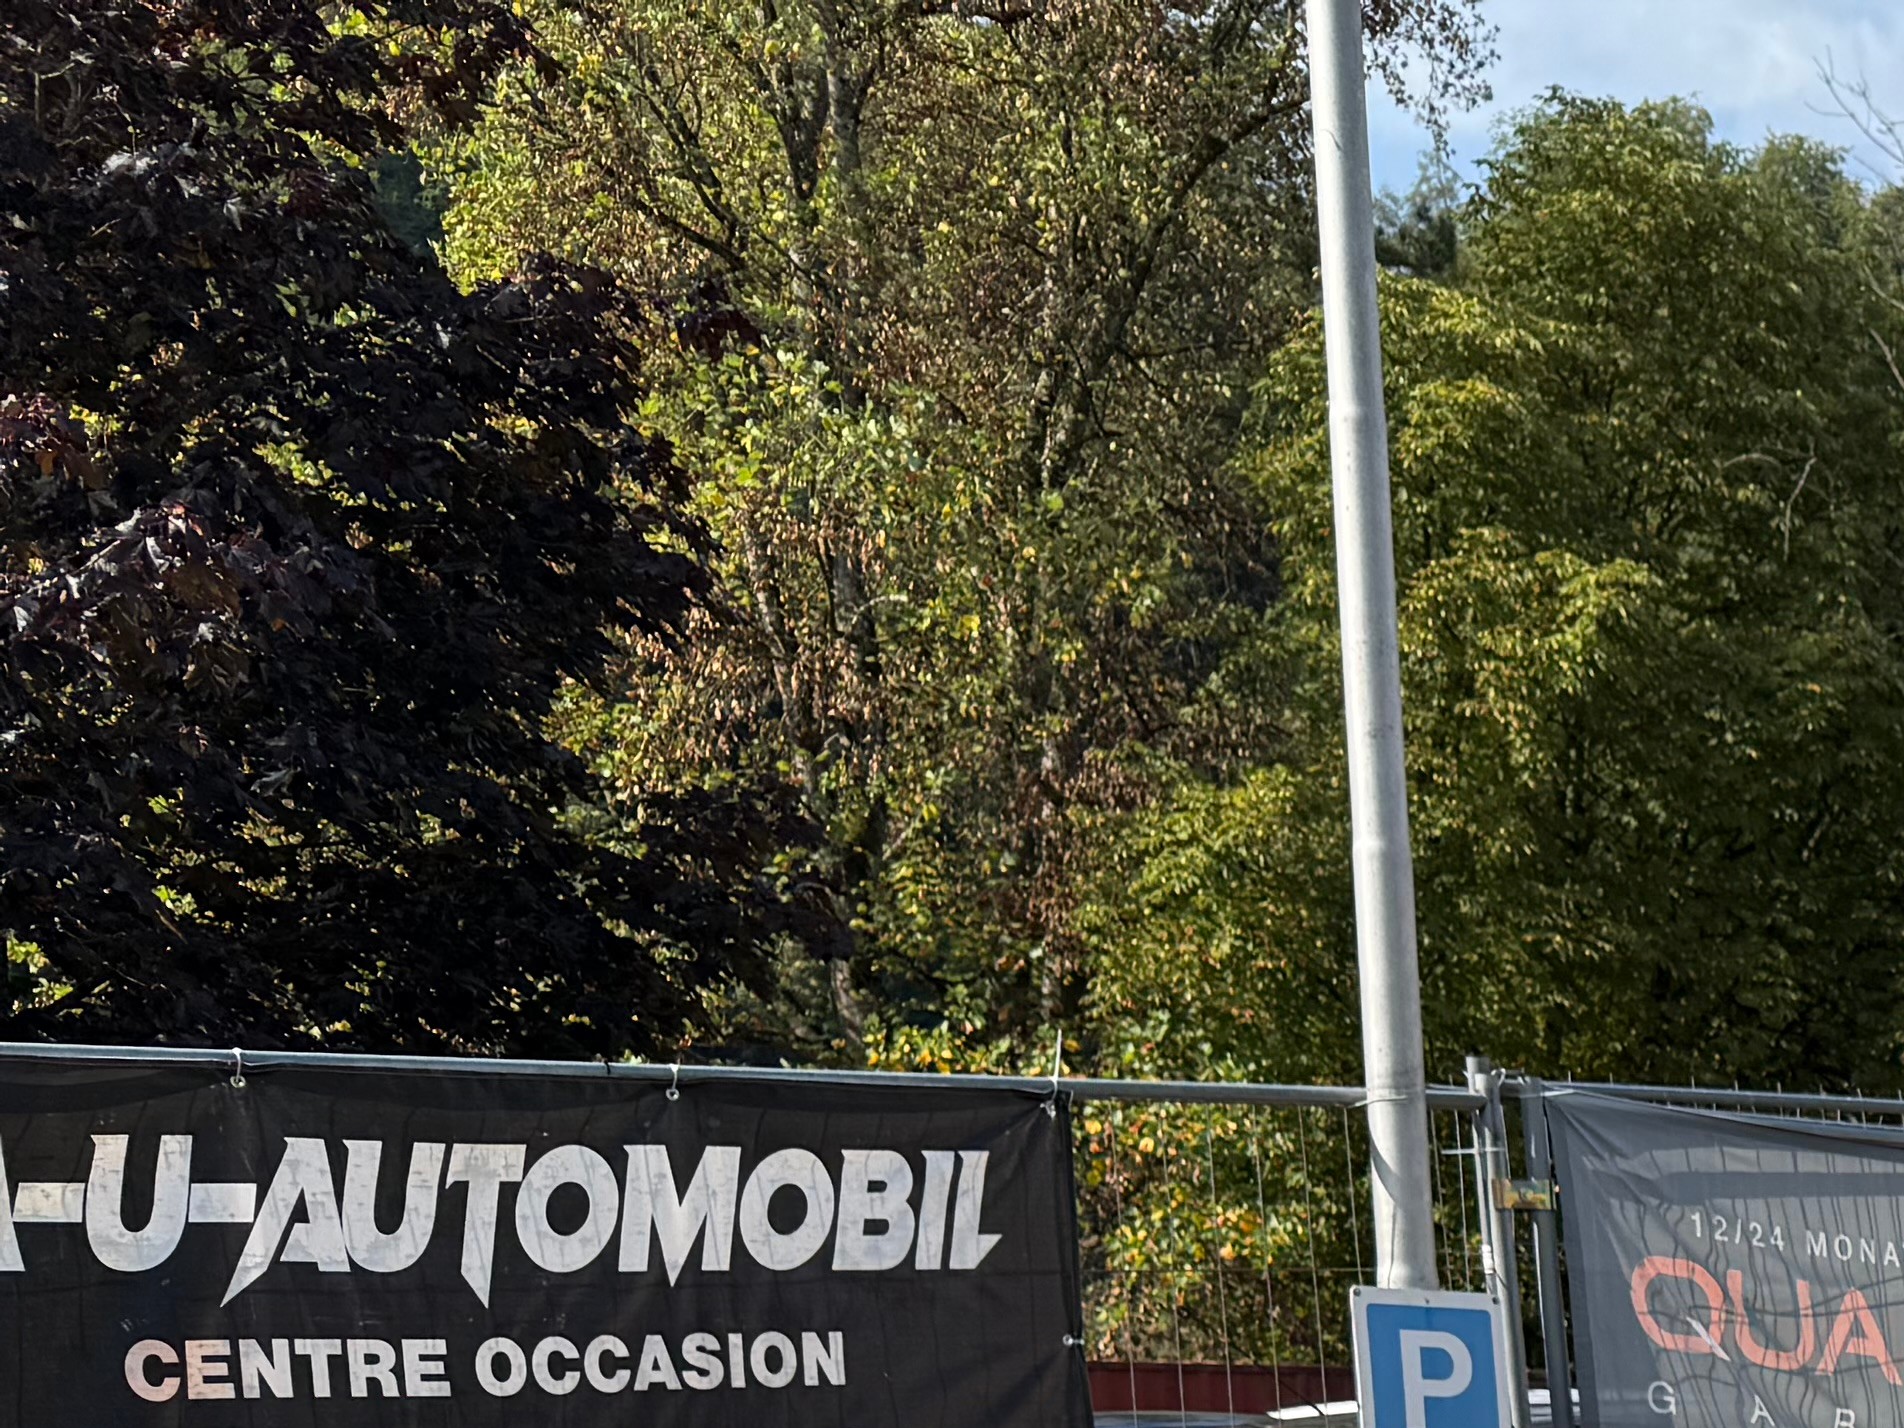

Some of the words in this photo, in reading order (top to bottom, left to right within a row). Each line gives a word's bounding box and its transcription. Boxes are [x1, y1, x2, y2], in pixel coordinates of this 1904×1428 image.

[0, 1134, 1003, 1309] -U-AUTOMOBIL
[1689, 1212, 1786, 1252] 12/24
[124, 1338, 452, 1402] CENTRE
[474, 1331, 847, 1398] OCCASION
